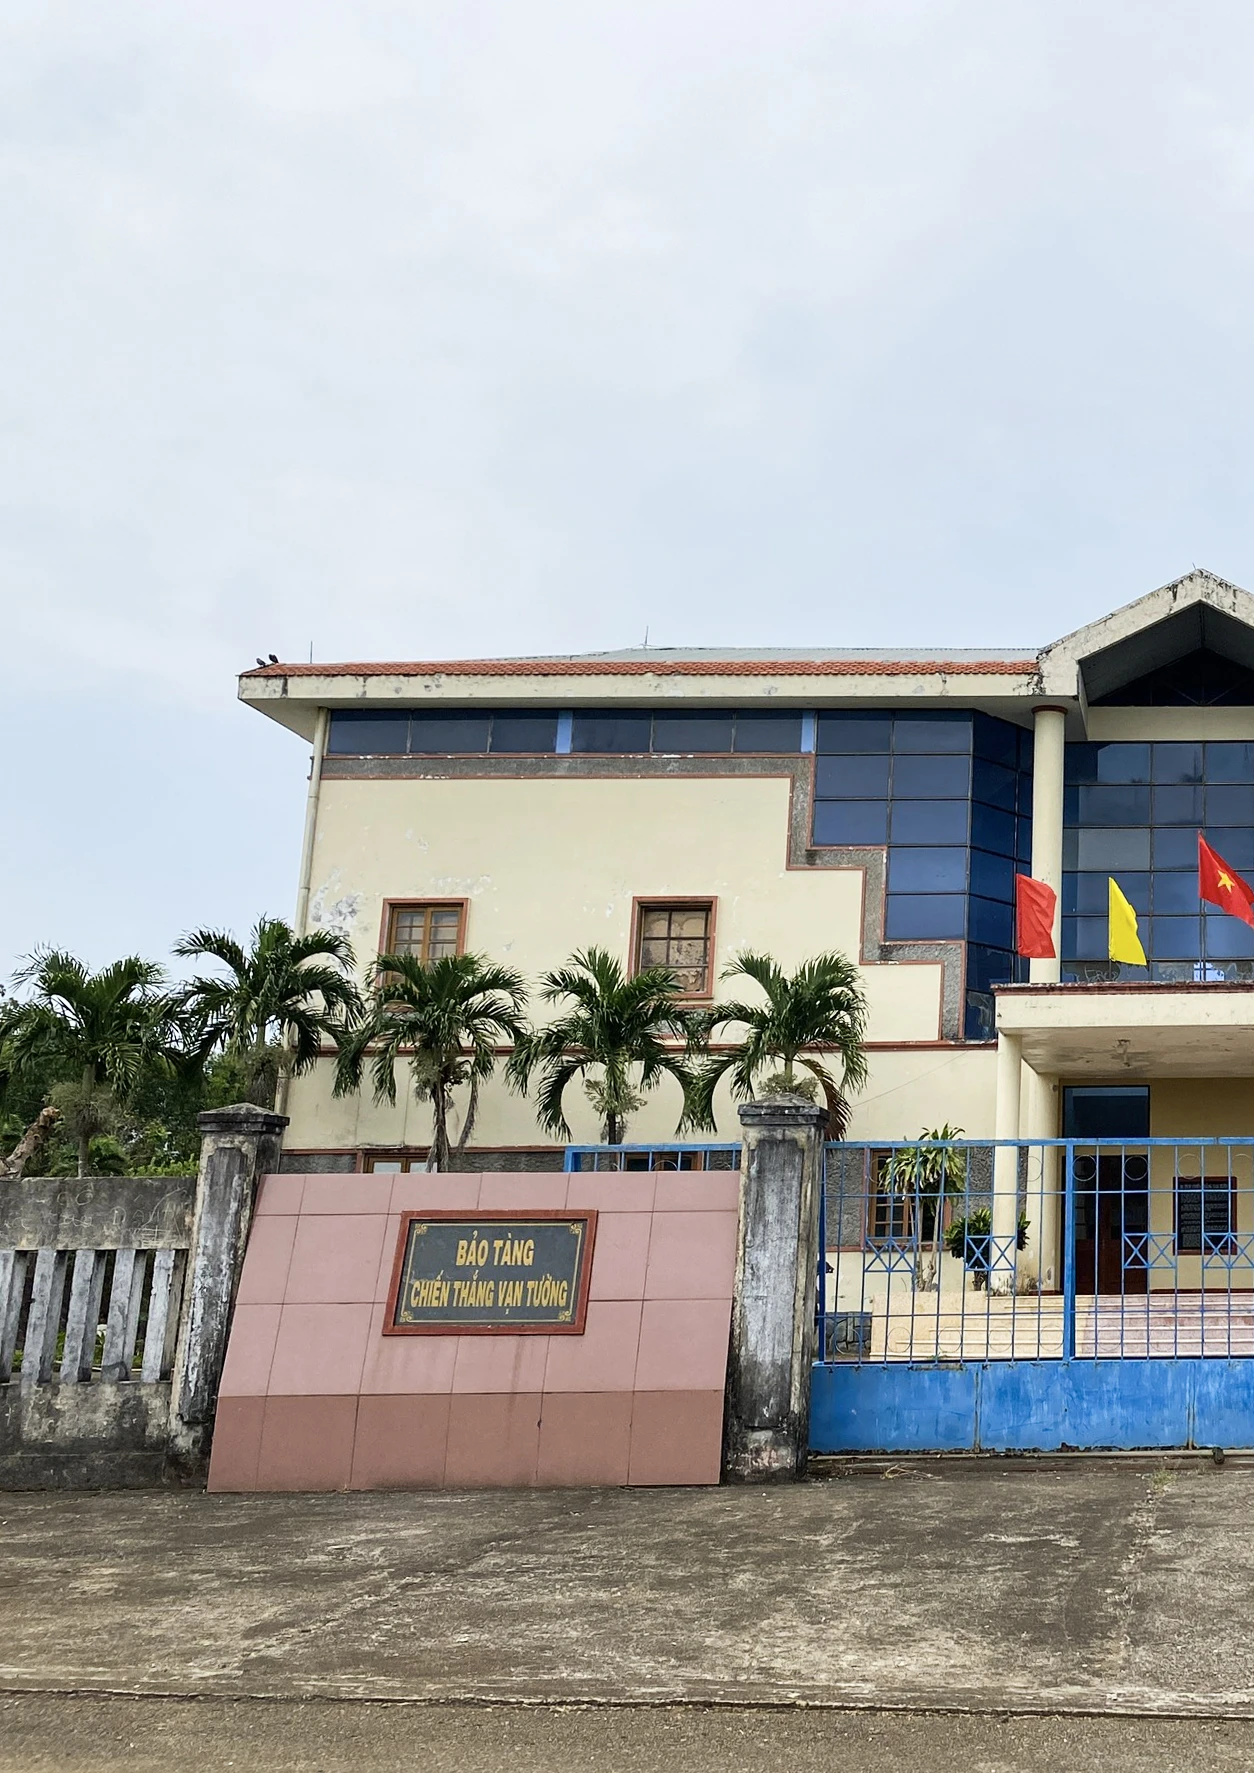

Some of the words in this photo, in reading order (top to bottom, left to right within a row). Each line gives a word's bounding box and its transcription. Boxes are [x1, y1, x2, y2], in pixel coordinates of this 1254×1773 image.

[455, 1230, 489, 1267] BẢO
[493, 1232, 535, 1267] TÀNG
[410, 1270, 451, 1308] CHIẾN
[452, 1270, 495, 1308] THẮNG
[497, 1279, 524, 1315] VẠN
[526, 1274, 568, 1308] TƯỜNG
